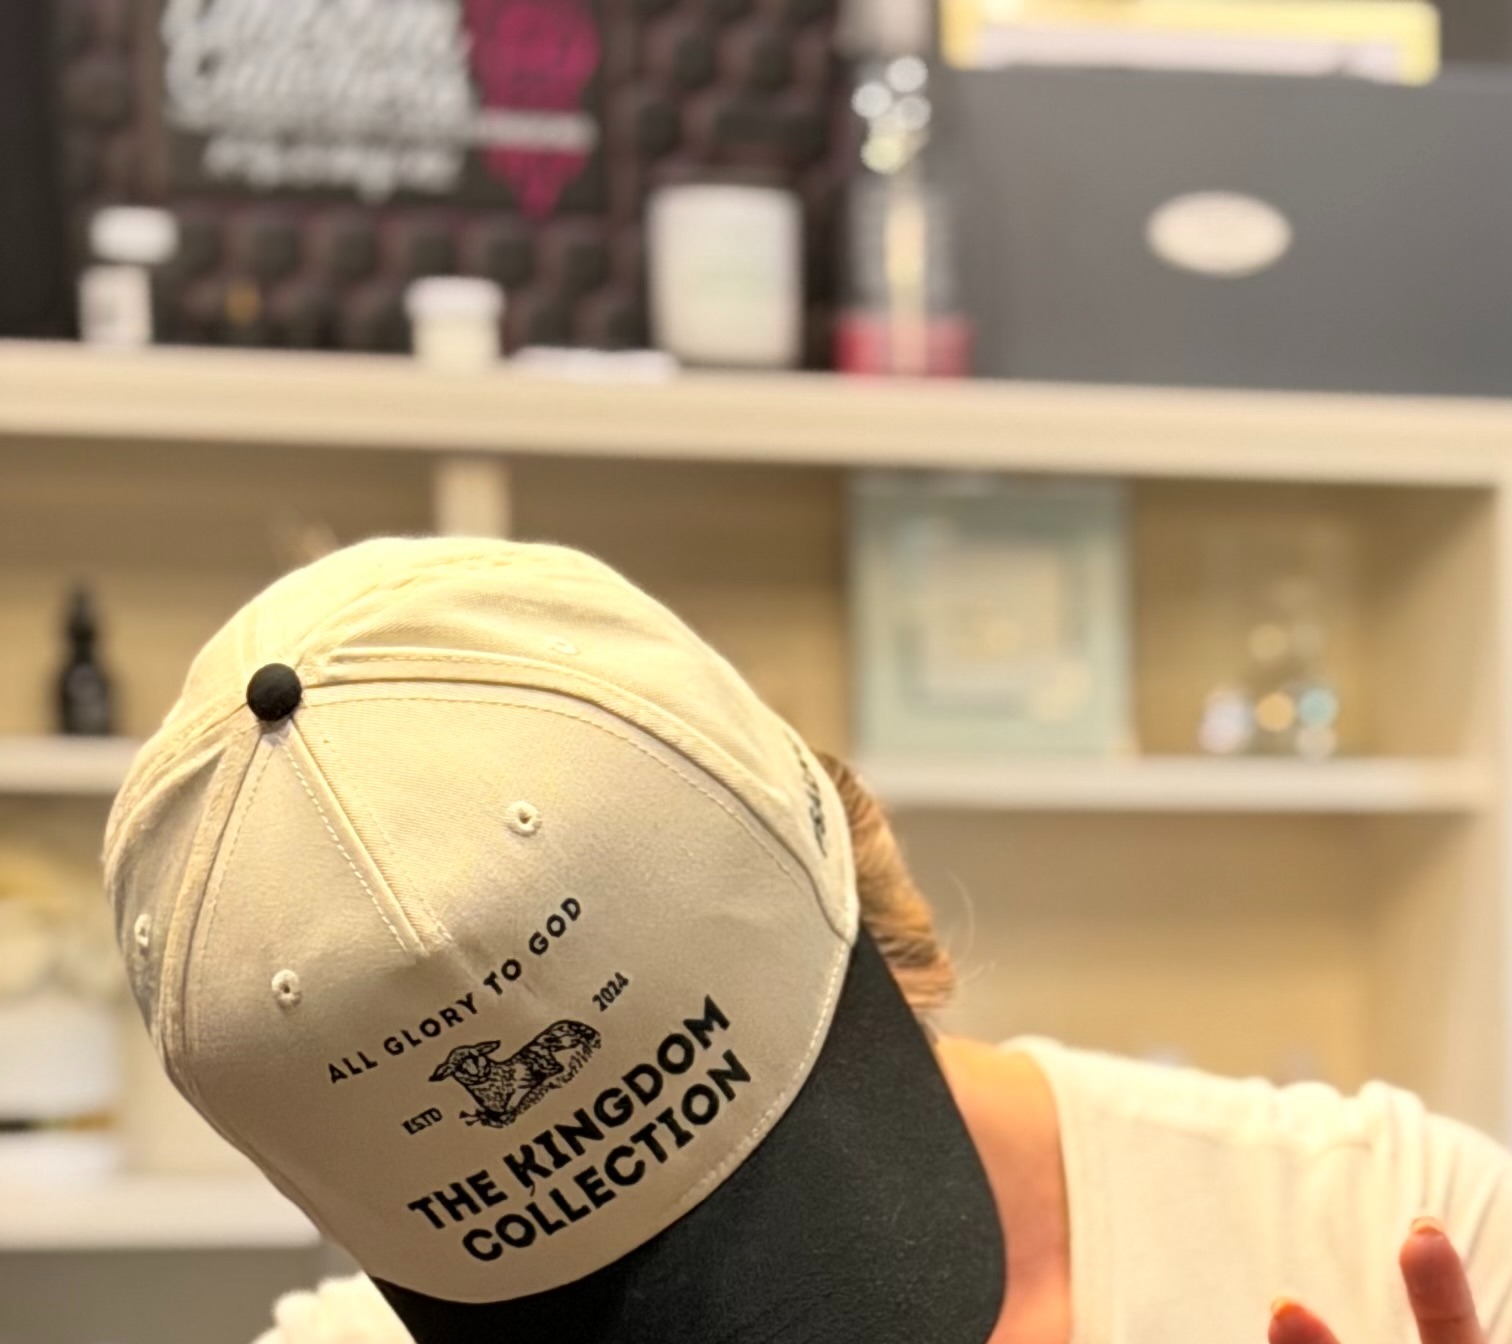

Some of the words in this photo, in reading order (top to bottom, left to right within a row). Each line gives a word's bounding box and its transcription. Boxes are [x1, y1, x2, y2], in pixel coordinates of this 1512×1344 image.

[328, 1051, 378, 1083] ALL
[384, 993, 477, 1056] GLORY
[483, 959, 522, 995] TO
[529, 897, 581, 955] GOD
[592, 972, 629, 1012] 2024
[407, 1170, 508, 1229] THE
[503, 994, 730, 1188] KINGDOM
[462, 1049, 751, 1261] COLLECTION
